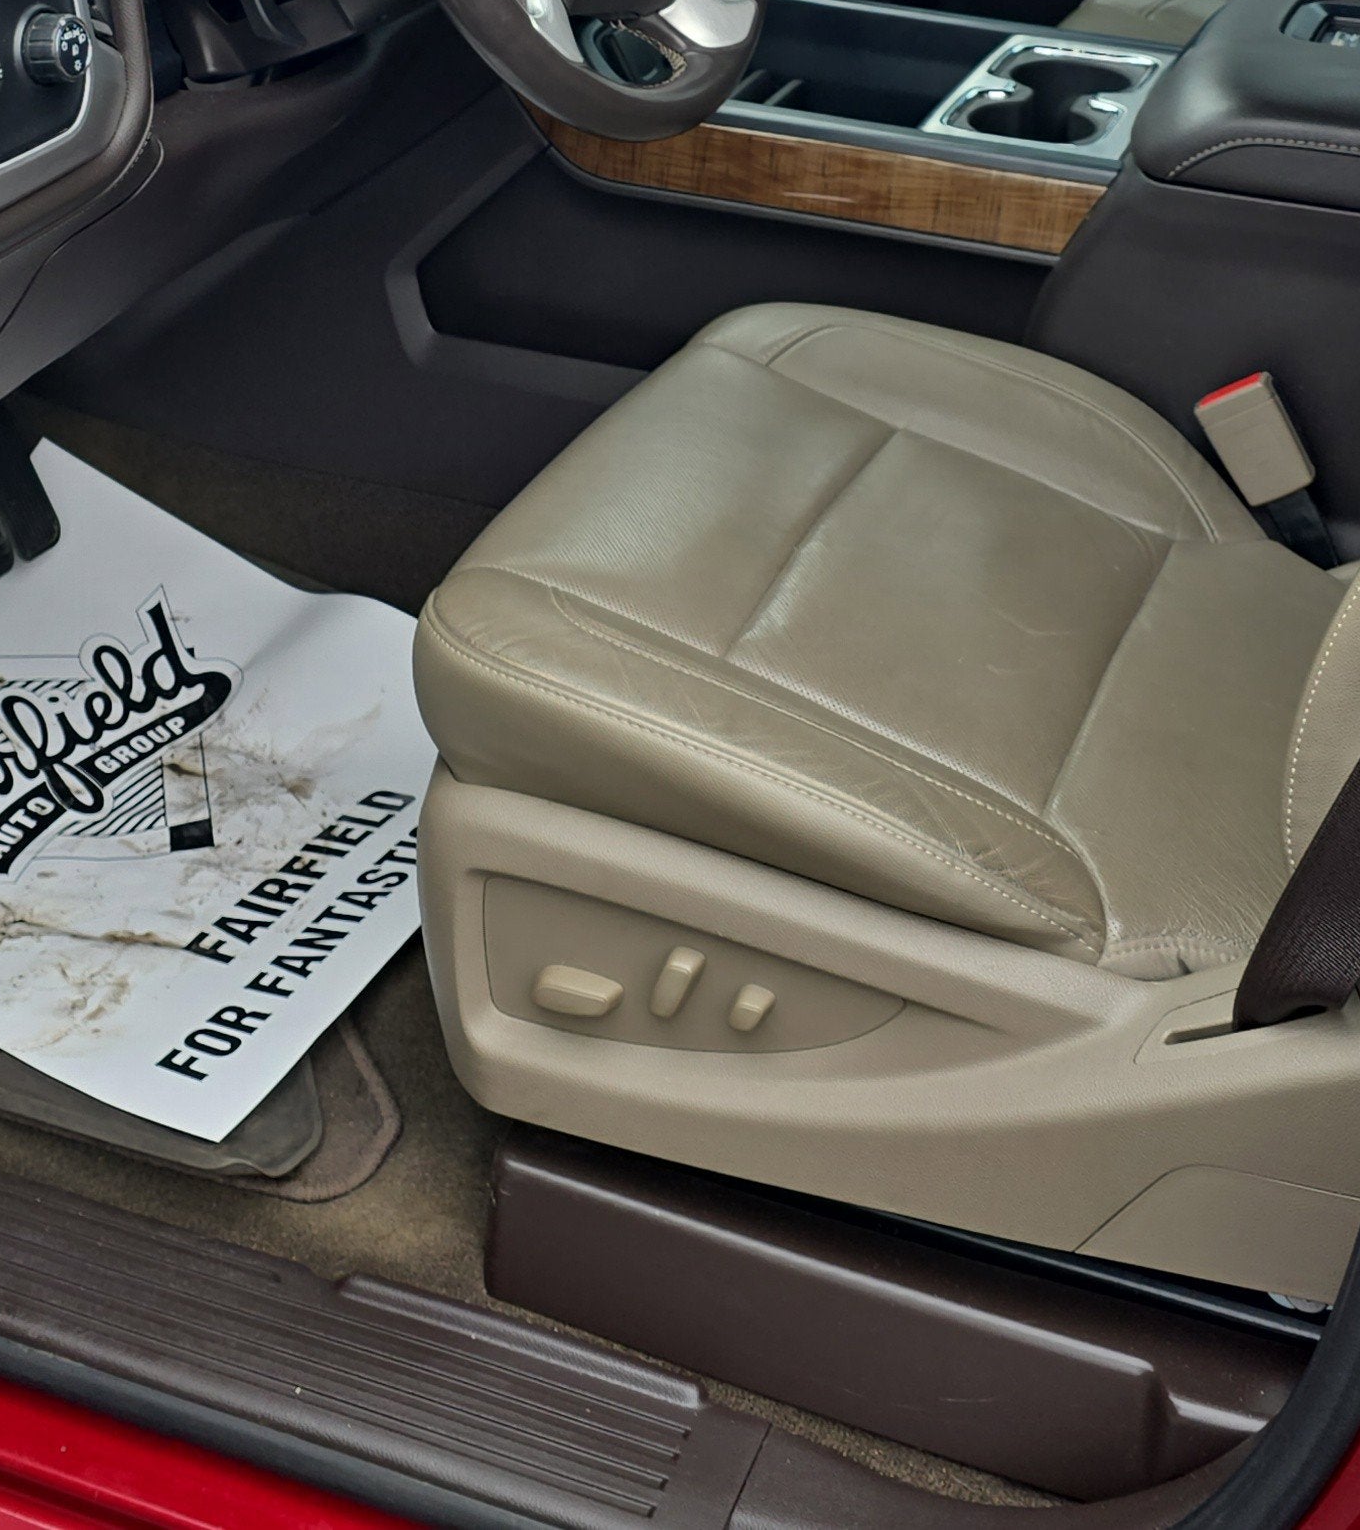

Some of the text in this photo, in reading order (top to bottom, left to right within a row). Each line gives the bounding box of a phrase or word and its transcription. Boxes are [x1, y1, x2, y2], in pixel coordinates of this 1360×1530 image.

[93, 716, 186, 774] GROUP
[155, 826, 419, 1082] FOR FANTAST
[183, 790, 416, 965] FAIRFIELD
